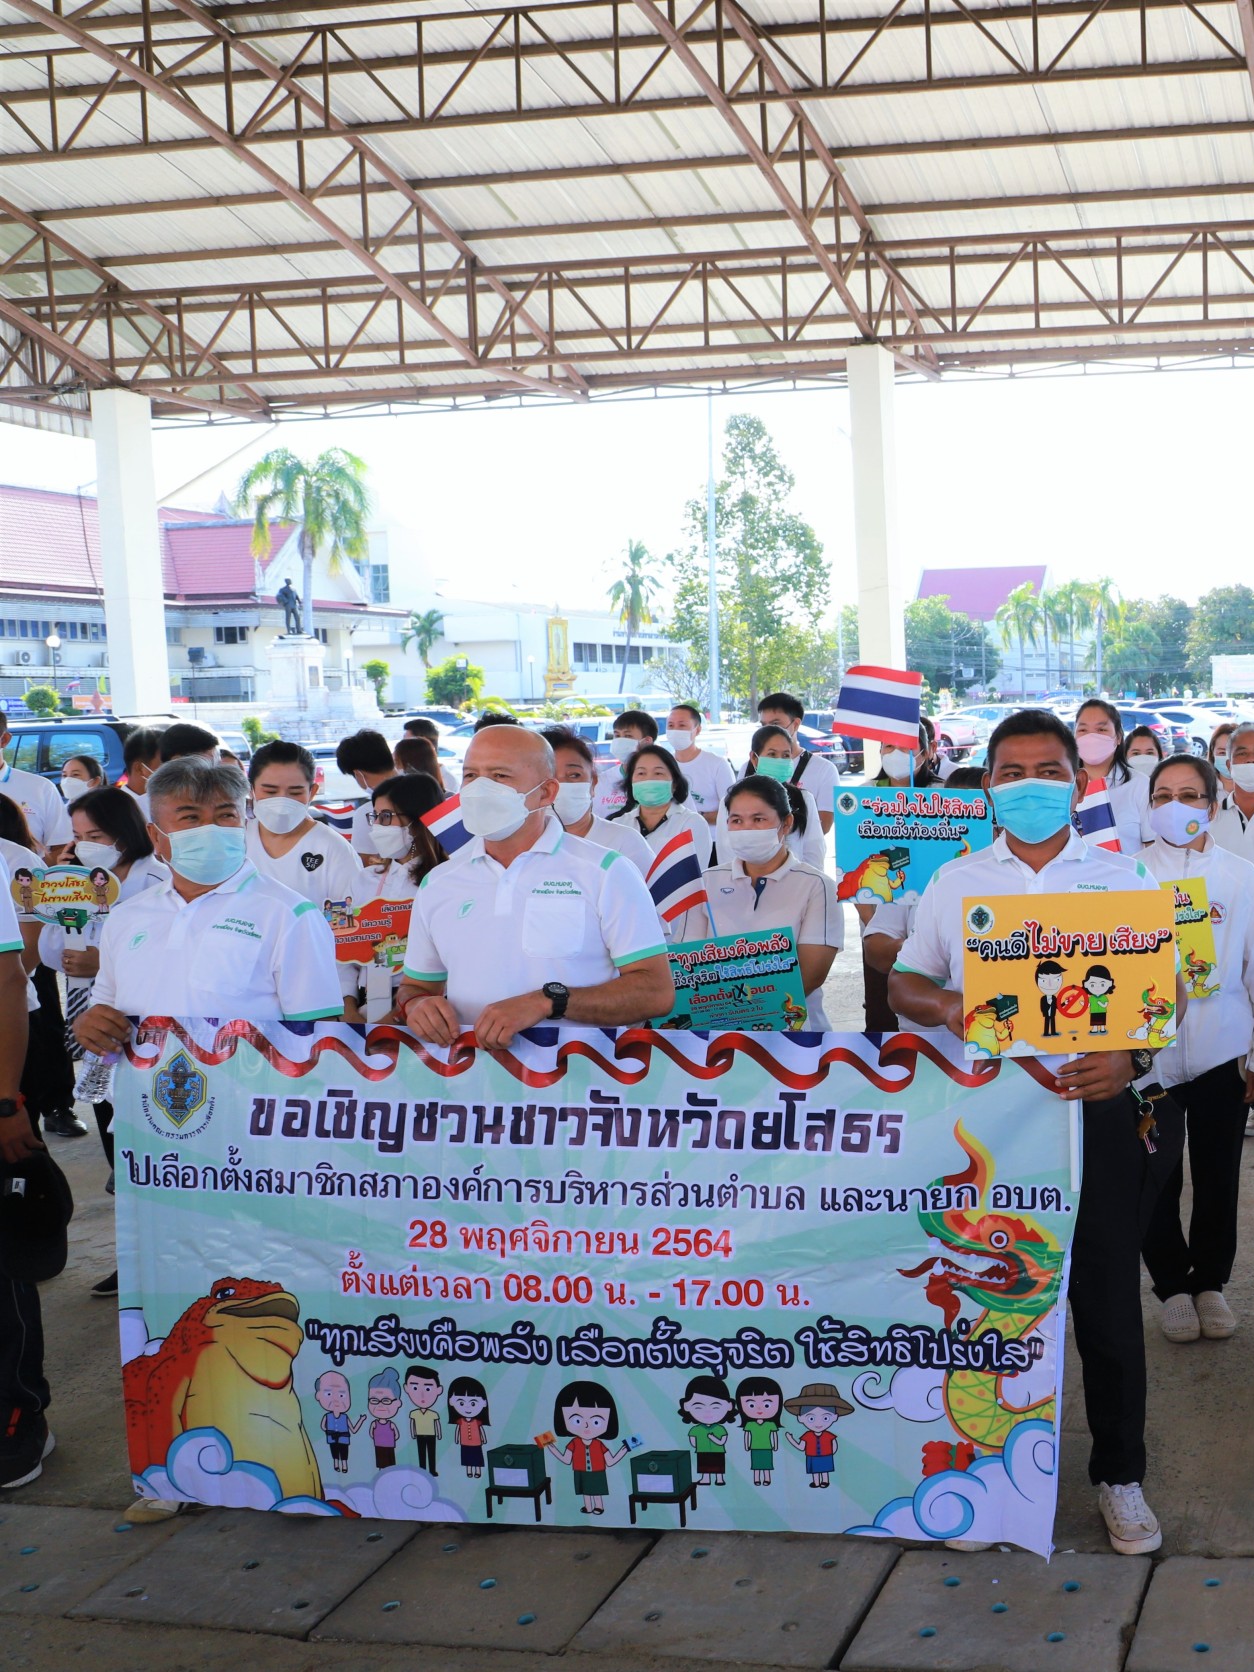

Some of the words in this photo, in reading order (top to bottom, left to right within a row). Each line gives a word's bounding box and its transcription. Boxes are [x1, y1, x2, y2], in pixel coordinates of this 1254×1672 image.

[861, 793, 986, 817] “ร่วมใจไปใช้สิทธิ
[858, 817, 967, 838] เลือกตั้งท้องถิ่น”
[306, 856, 319, 865] TEE
[668, 934, 790, 970] “ทุกเสียงคือพลัง
[249, 1088, 905, 1154] ขอเชิญชวนชาวจังหวัดยโสธร
[122, 1145, 806, 1212] ไปเลือกตั้งสมาชิกสภาองค์การบริหารส่วนตำบล
[820, 1184, 978, 1213] และนายก
[991, 1185, 1072, 1213] อบต.
[408, 1219, 448, 1249] 28
[459, 1219, 639, 1260] พฤศจิกายน
[651, 1227, 733, 1259] 2564
[341, 1250, 491, 1300] ตั้งแต่เวลา
[503, 1274, 592, 1304] 08.00
[604, 1280, 636, 1305] น.
[672, 1278, 766, 1307] 17.00
[777, 1281, 811, 1307] น.
[308, 1317, 549, 1363] "ทุกเสียงคือพลัง
[560, 1319, 791, 1374] เลือกตั้งสุจริต
[800, 1318, 1044, 1367] ใช้สิทธิโปร่งใส"
